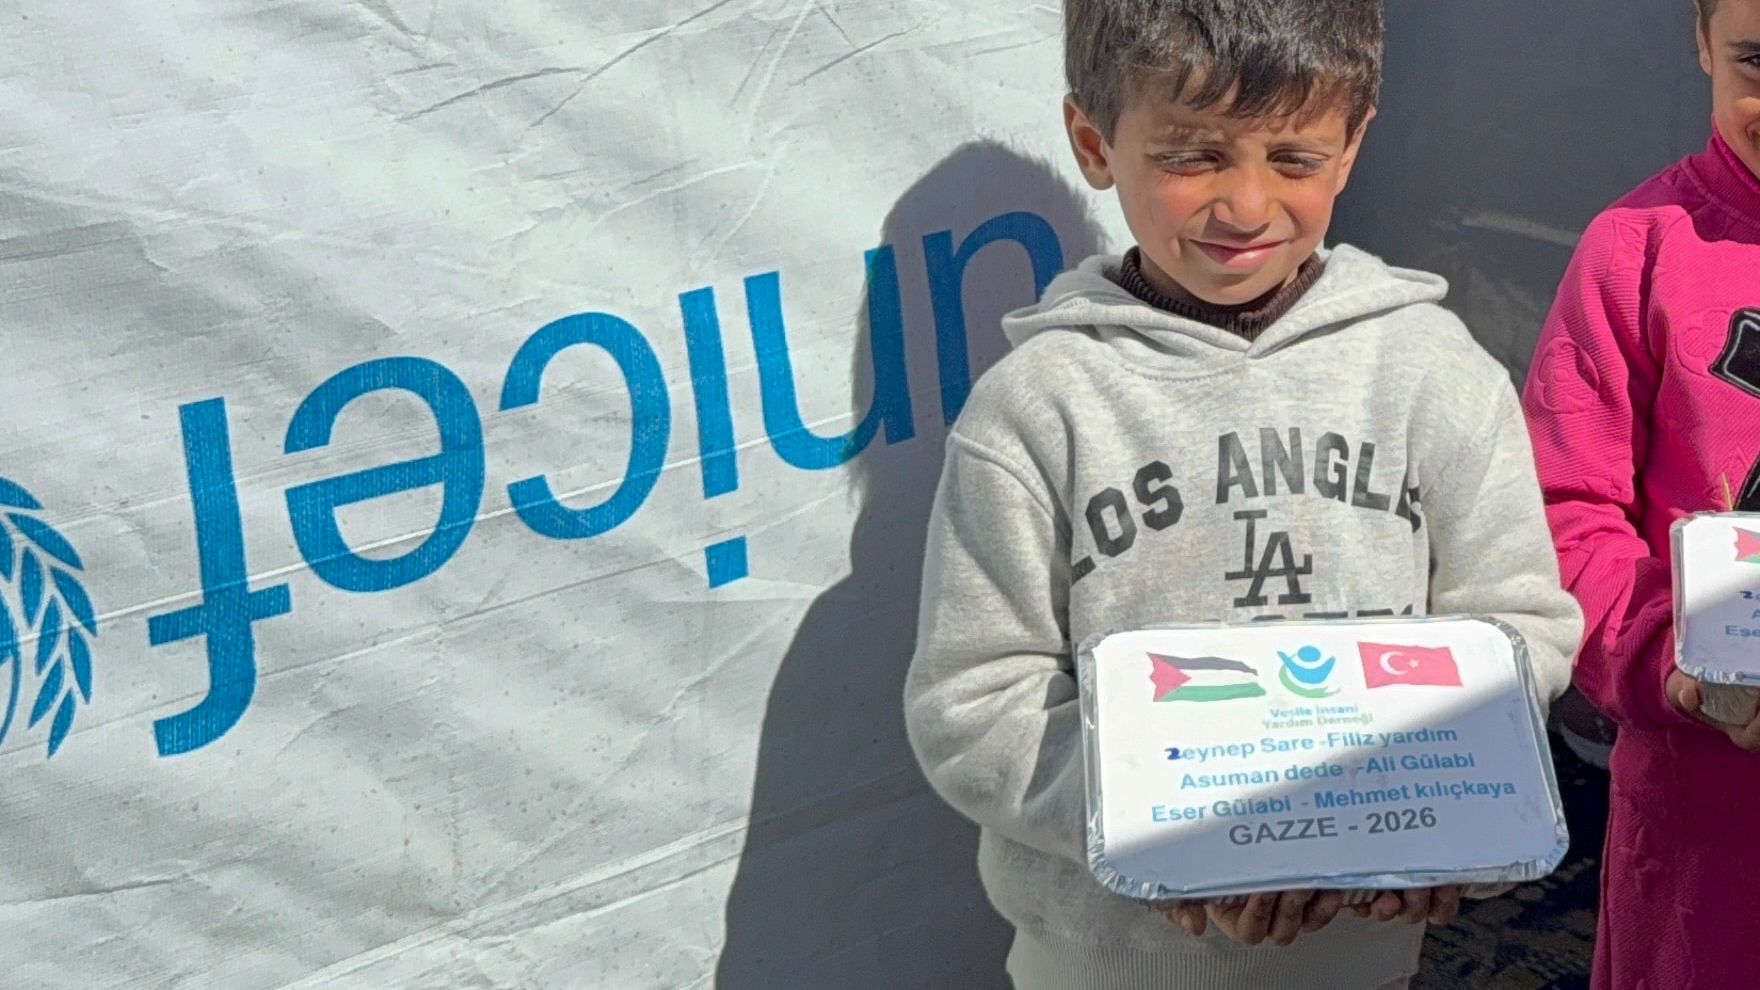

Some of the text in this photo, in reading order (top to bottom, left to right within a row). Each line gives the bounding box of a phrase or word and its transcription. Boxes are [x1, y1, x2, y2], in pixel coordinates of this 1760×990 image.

[146, 209, 1065, 757] unicef
[1225, 509, 1313, 608] LA
[1260, 733, 1314, 753] Sare
[1378, 726, 1458, 750] yardım
[1180, 751, 1476, 790] Asuman dede -Ali Gülabi
[1152, 803, 1208, 823] Eser
[1212, 795, 1292, 819] Gülabi
[1314, 786, 1411, 810] Mehmet
[1416, 778, 1517, 804] kılıçkaya
[1228, 815, 1339, 847] GAZZE
[1367, 805, 1438, 836] 2026
